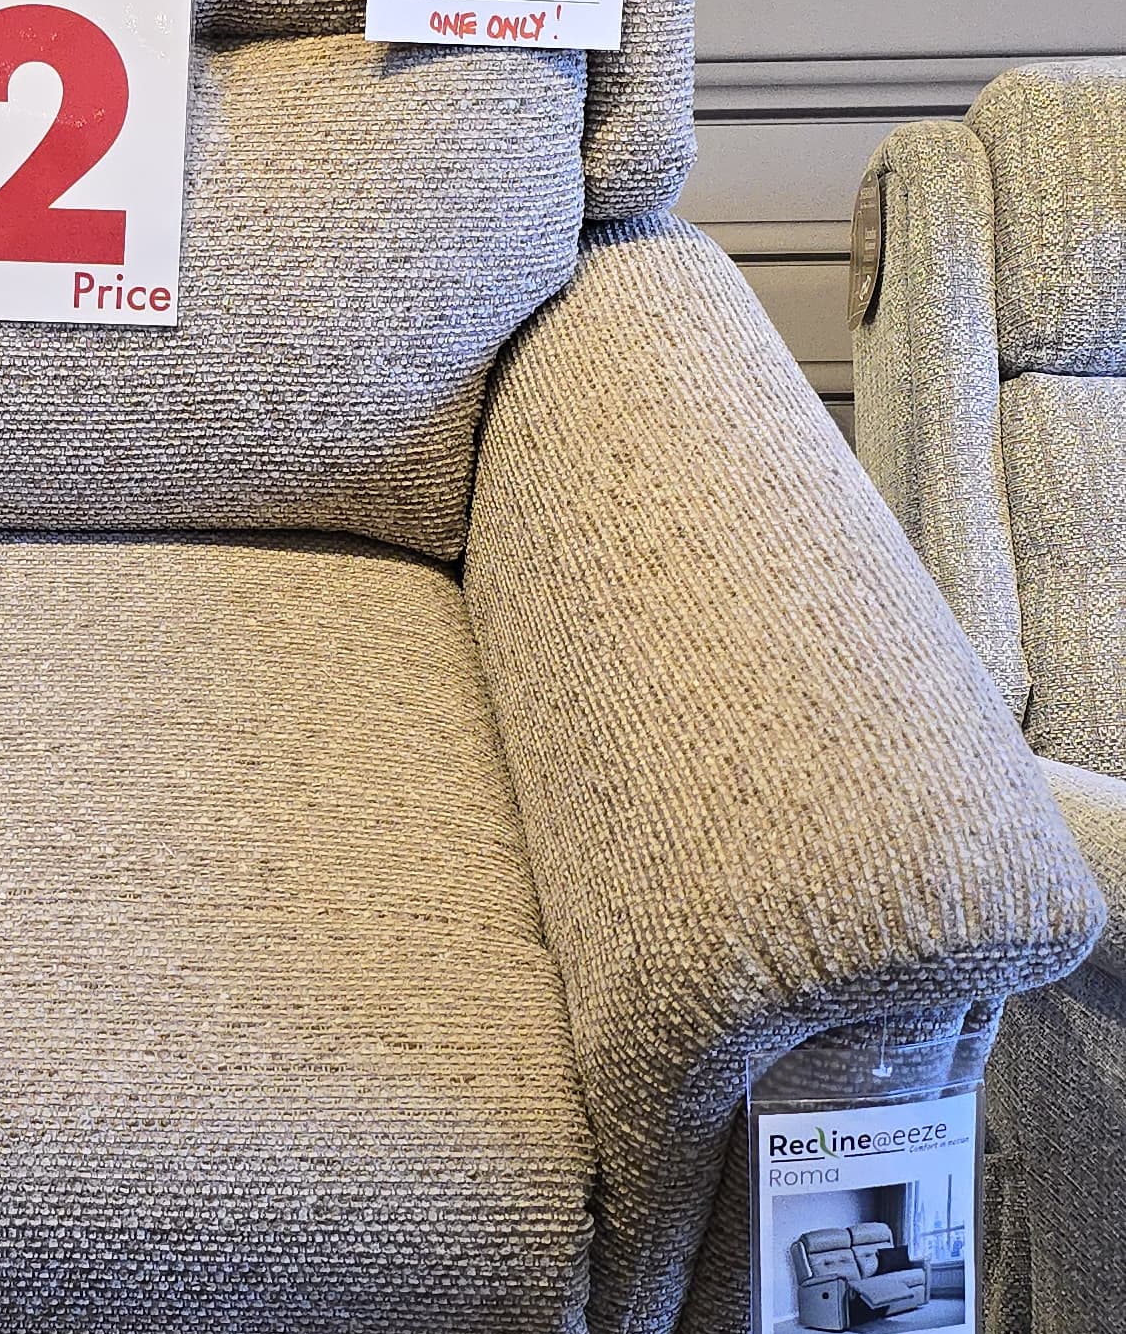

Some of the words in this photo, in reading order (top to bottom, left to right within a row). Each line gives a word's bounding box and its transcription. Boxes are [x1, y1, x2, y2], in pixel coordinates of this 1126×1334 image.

[429, 11, 477, 40] ONE
[73, 272, 171, 312] Price
[769, 1167, 840, 1188] Roma
